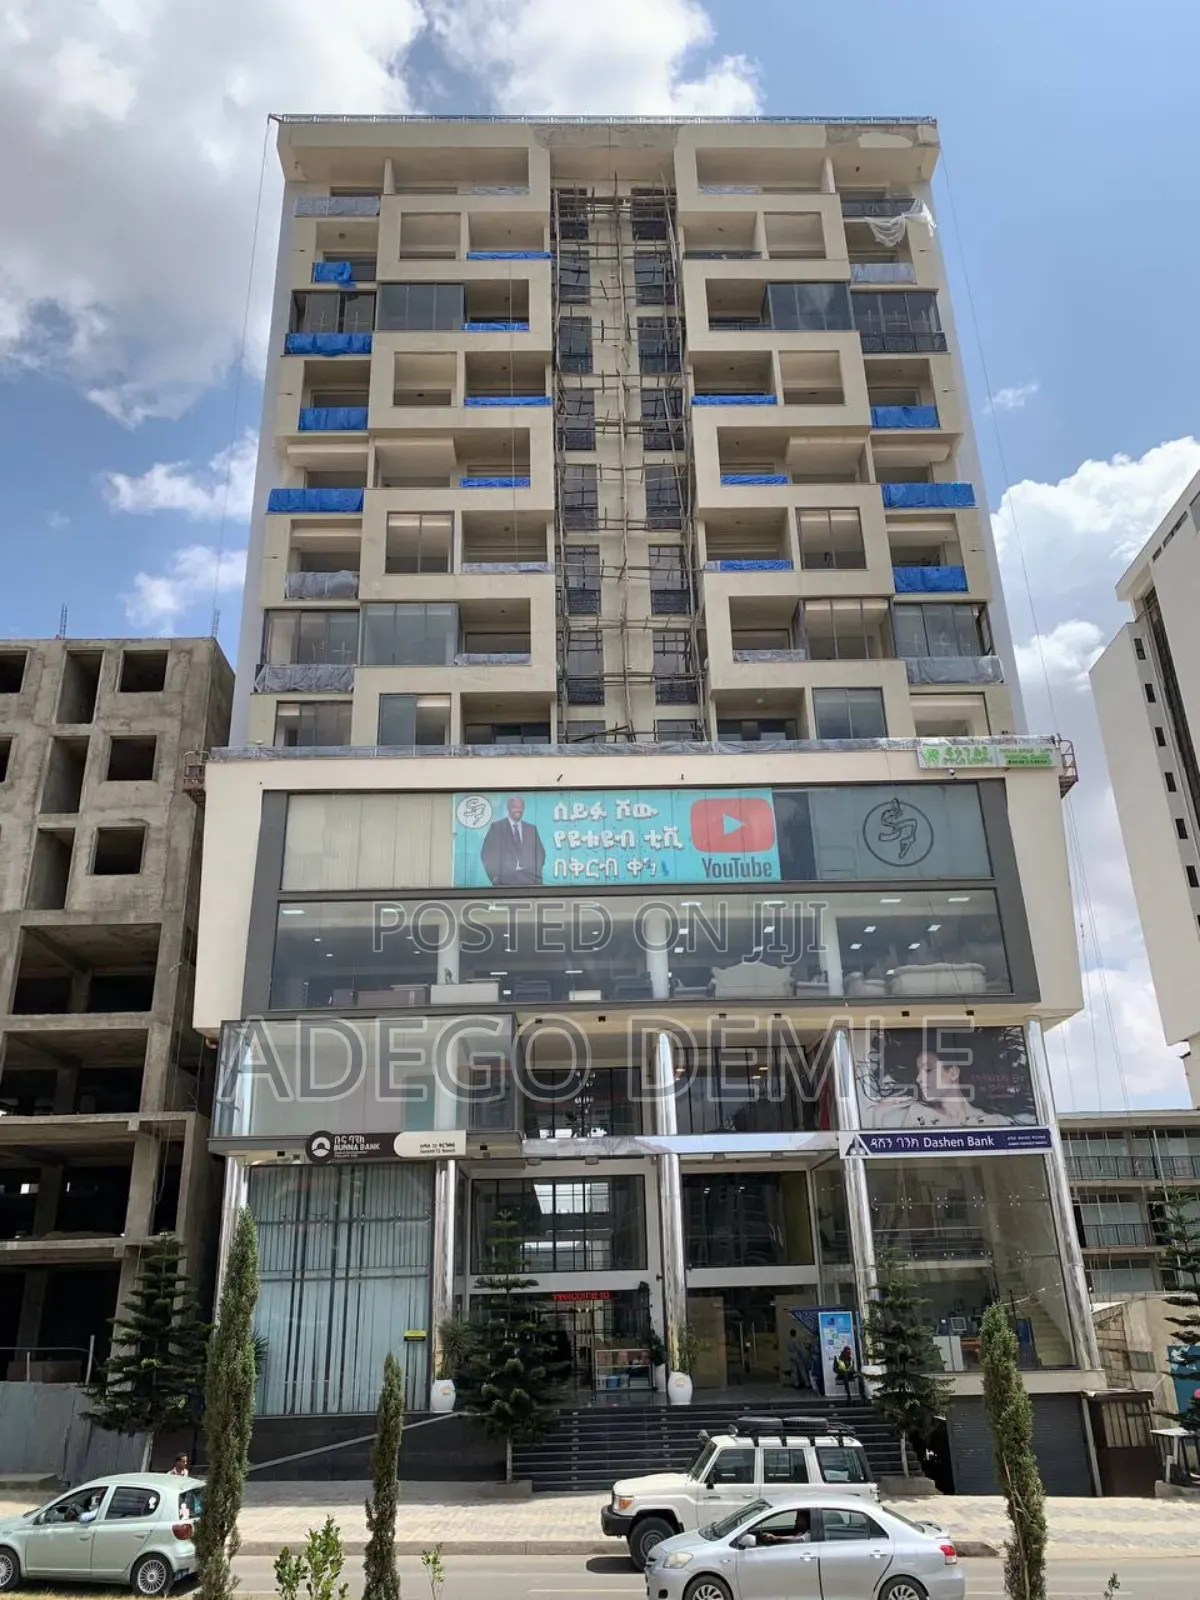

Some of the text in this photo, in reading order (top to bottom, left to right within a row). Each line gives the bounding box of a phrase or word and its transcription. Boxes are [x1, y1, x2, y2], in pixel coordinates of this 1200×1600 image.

[702, 856, 773, 878] YouTube
[334, 1142, 381, 1151] BUNNA BANK
[870, 1138, 892, 1149] ዳሸን
[896, 1136, 920, 1149] ባንክ
[923, 1136, 965, 1149] Dashen
[968, 1134, 995, 1147] Bank
